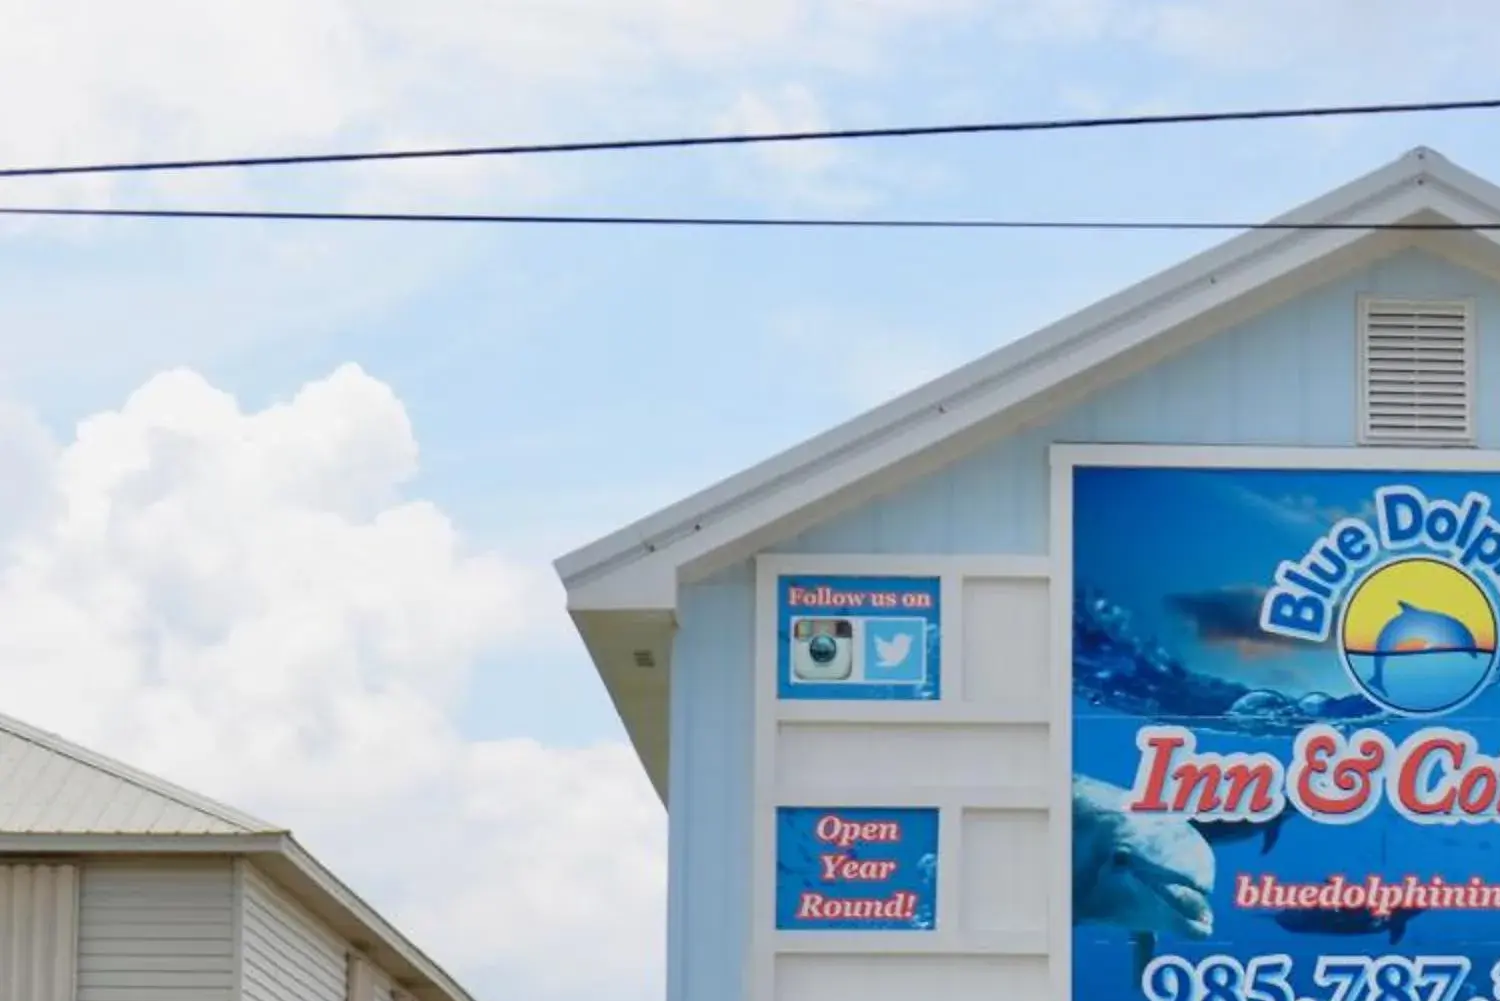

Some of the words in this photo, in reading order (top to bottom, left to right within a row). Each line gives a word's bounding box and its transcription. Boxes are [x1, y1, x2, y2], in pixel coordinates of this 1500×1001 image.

[1266, 524, 1372, 637] Blue
[788, 586, 864, 607] Follow
[871, 591, 897, 607] us
[902, 592, 932, 607] on
[1130, 735, 1276, 815] Inn
[1300, 733, 1387, 816] &
[816, 815, 899, 846] Open
[821, 854, 896, 880] Year
[798, 891, 917, 918] Round!
